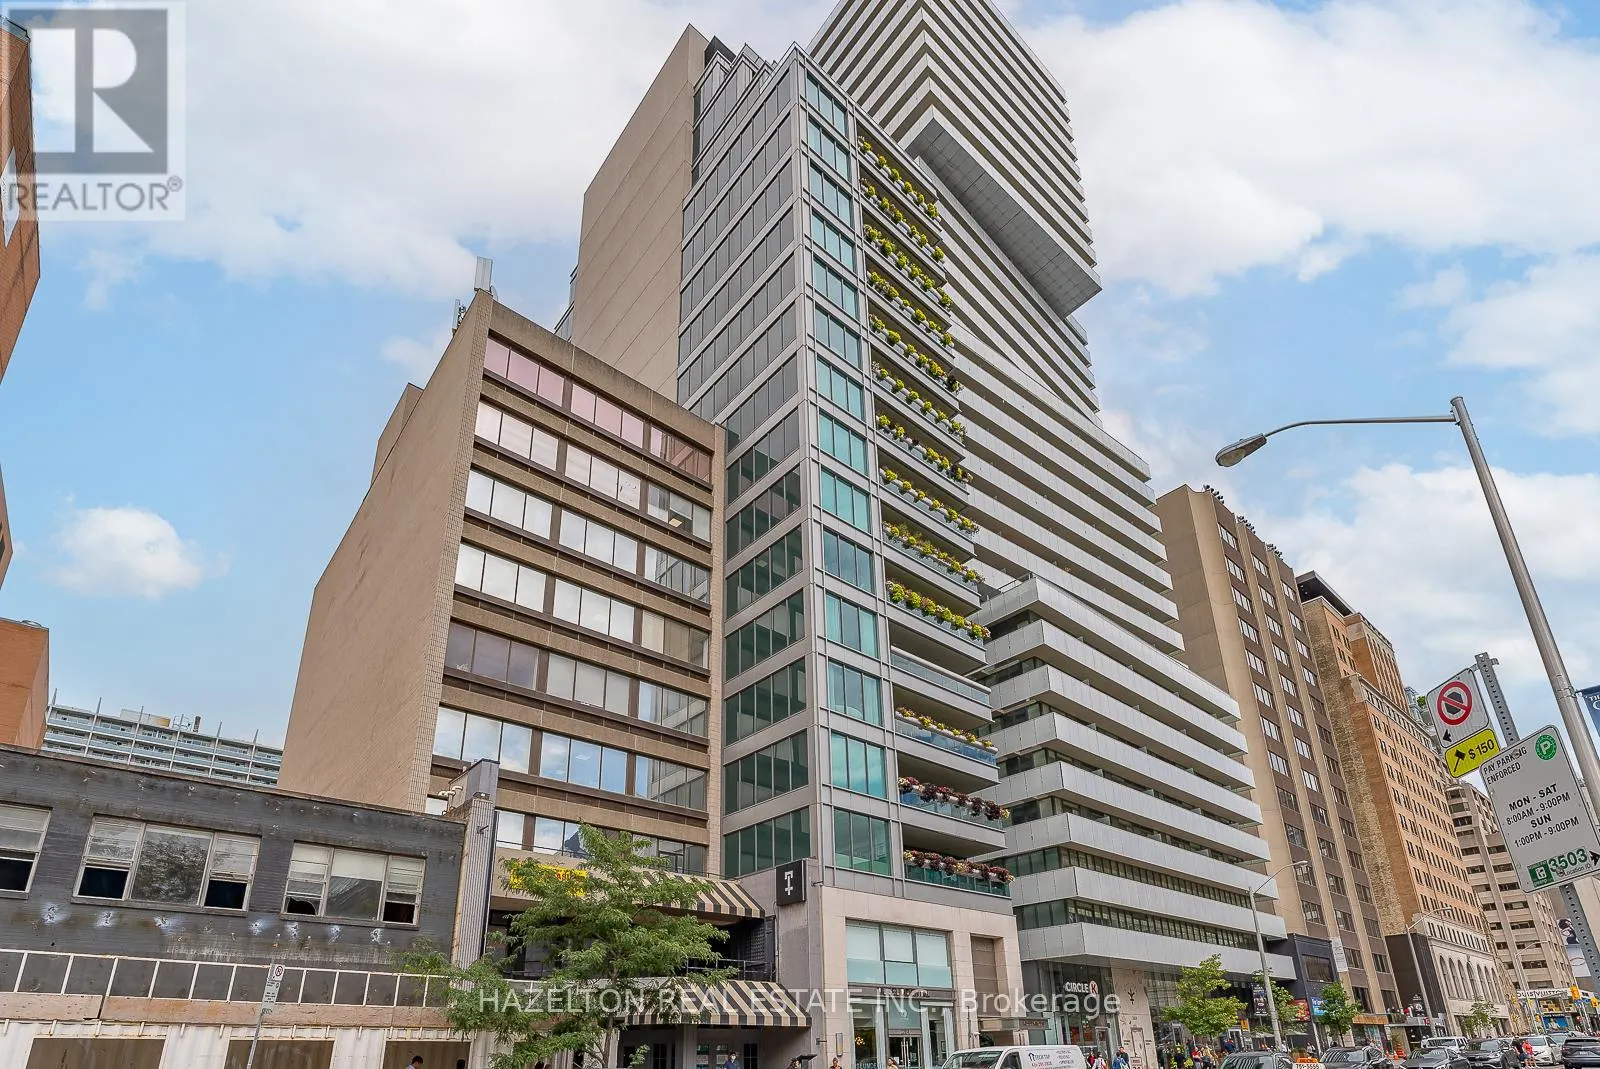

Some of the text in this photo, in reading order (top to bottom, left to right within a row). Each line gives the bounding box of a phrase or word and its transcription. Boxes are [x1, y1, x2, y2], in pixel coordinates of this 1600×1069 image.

[1484, 747, 1527, 774] PAY PARKG
[1487, 762, 1520, 784] ENFORCED
[1506, 808, 1534, 825] 8:00AM
[1540, 792, 1570, 812] 9:00PM
[1508, 796, 1530, 811] MON
[1538, 784, 1558, 798] SAT
[1515, 831, 1542, 847] 1:00PM
[1548, 816, 1579, 835] 9:00PM
[1531, 814, 1552, 828] SUN
[1548, 849, 1587, 872] 3503
[1564, 866, 1584, 876] ocation
[1065, 982, 1089, 993] CIRCLE
